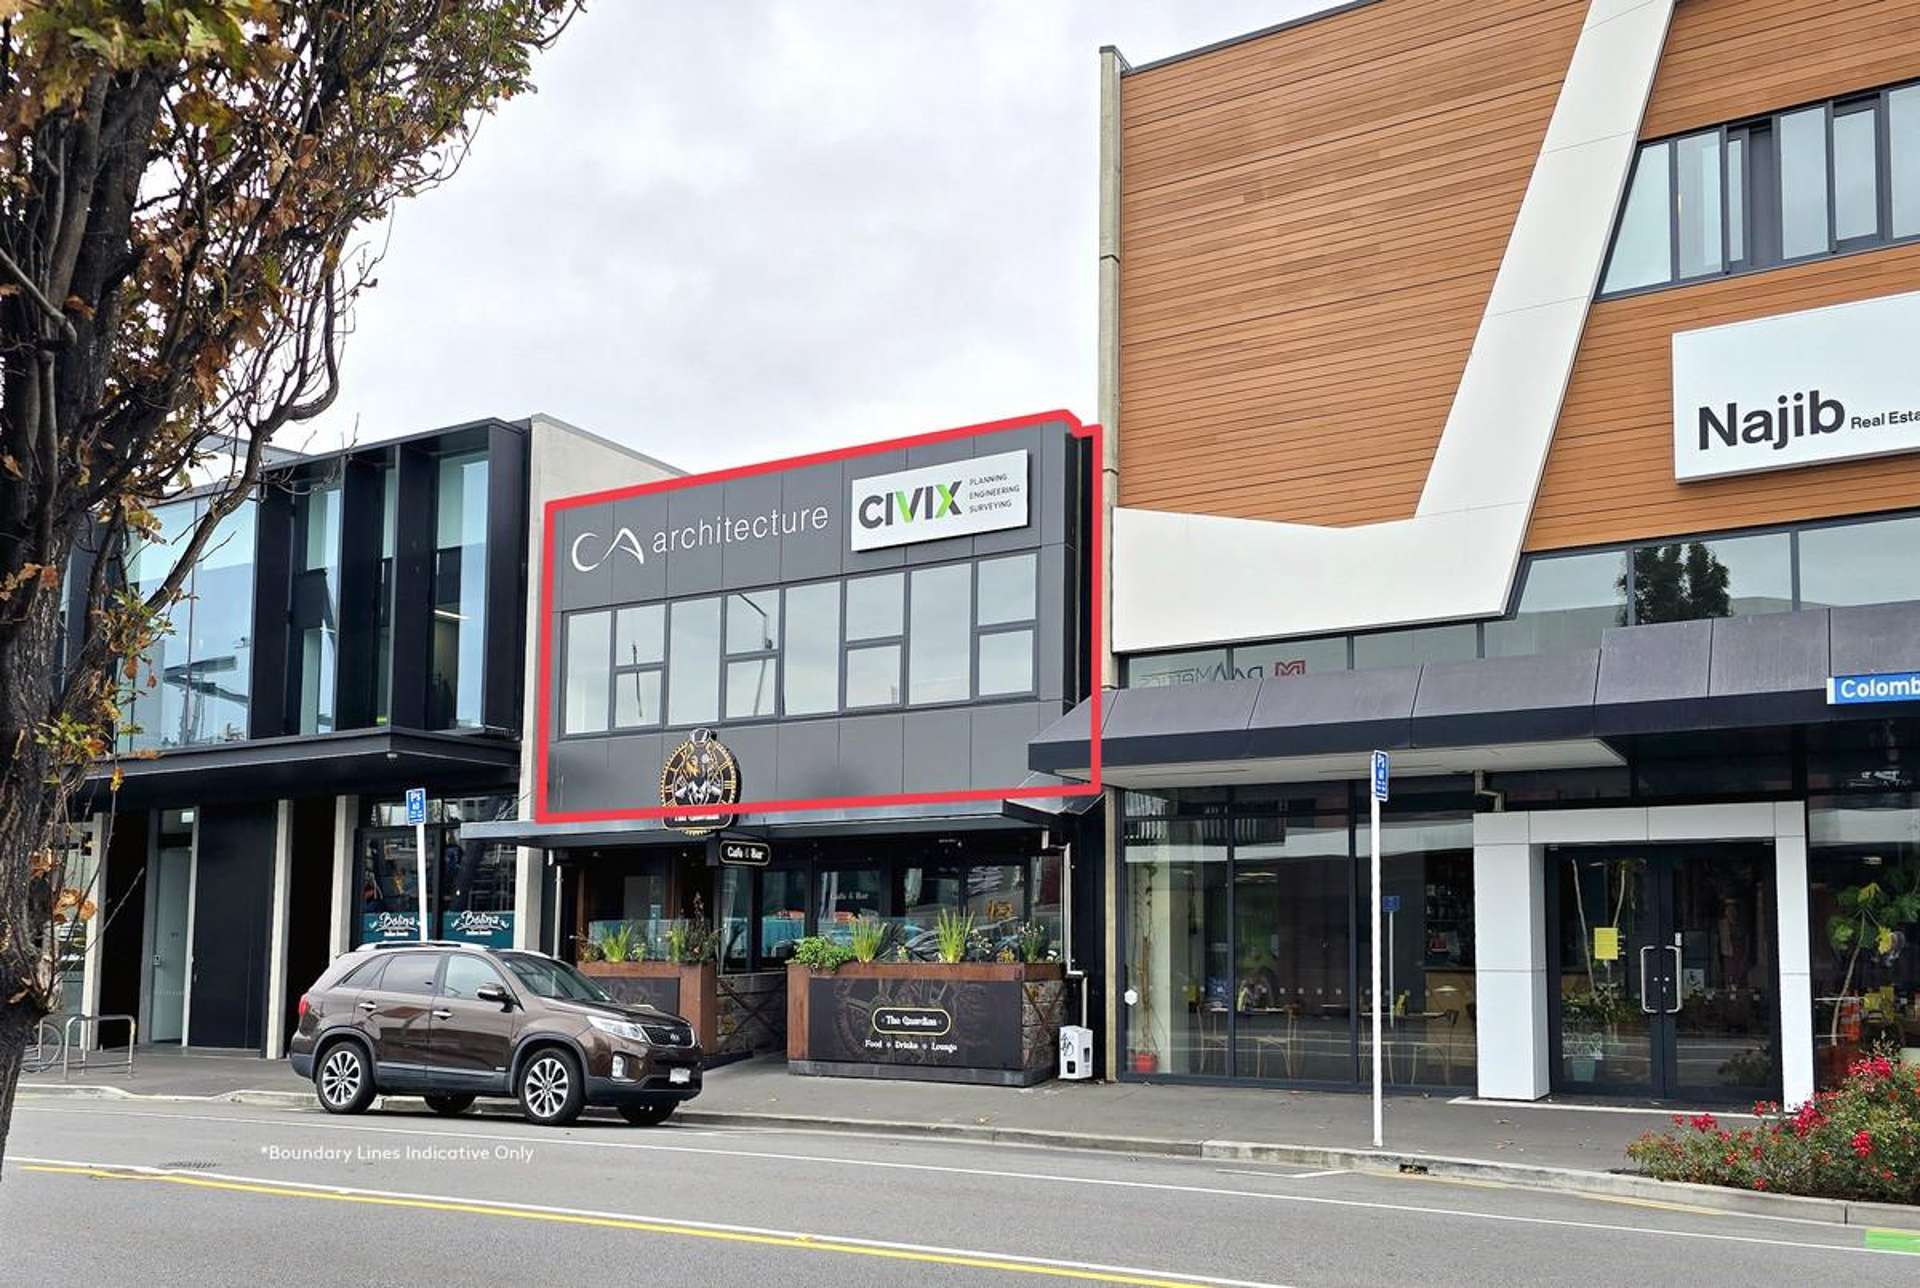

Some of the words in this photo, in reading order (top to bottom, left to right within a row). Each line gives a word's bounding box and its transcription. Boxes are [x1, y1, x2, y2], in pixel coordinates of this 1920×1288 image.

[1699, 390, 1845, 450] Najib
[1851, 413, 1885, 429] Real
[969, 474, 1008, 486] PLANNING
[969, 485, 1020, 500] ENGINEERING
[858, 480, 962, 529] CIVIX
[969, 499, 1012, 513] SURVEYING
[571, 528, 644, 571] CA
[652, 506, 828, 553] architecture
[886, 1015, 900, 1025] The
[902, 1016, 937, 1026] Guardian
[865, 1040, 882, 1048] Food
[895, 1041, 918, 1049] Drinks
[931, 1042, 957, 1053] Lounge
